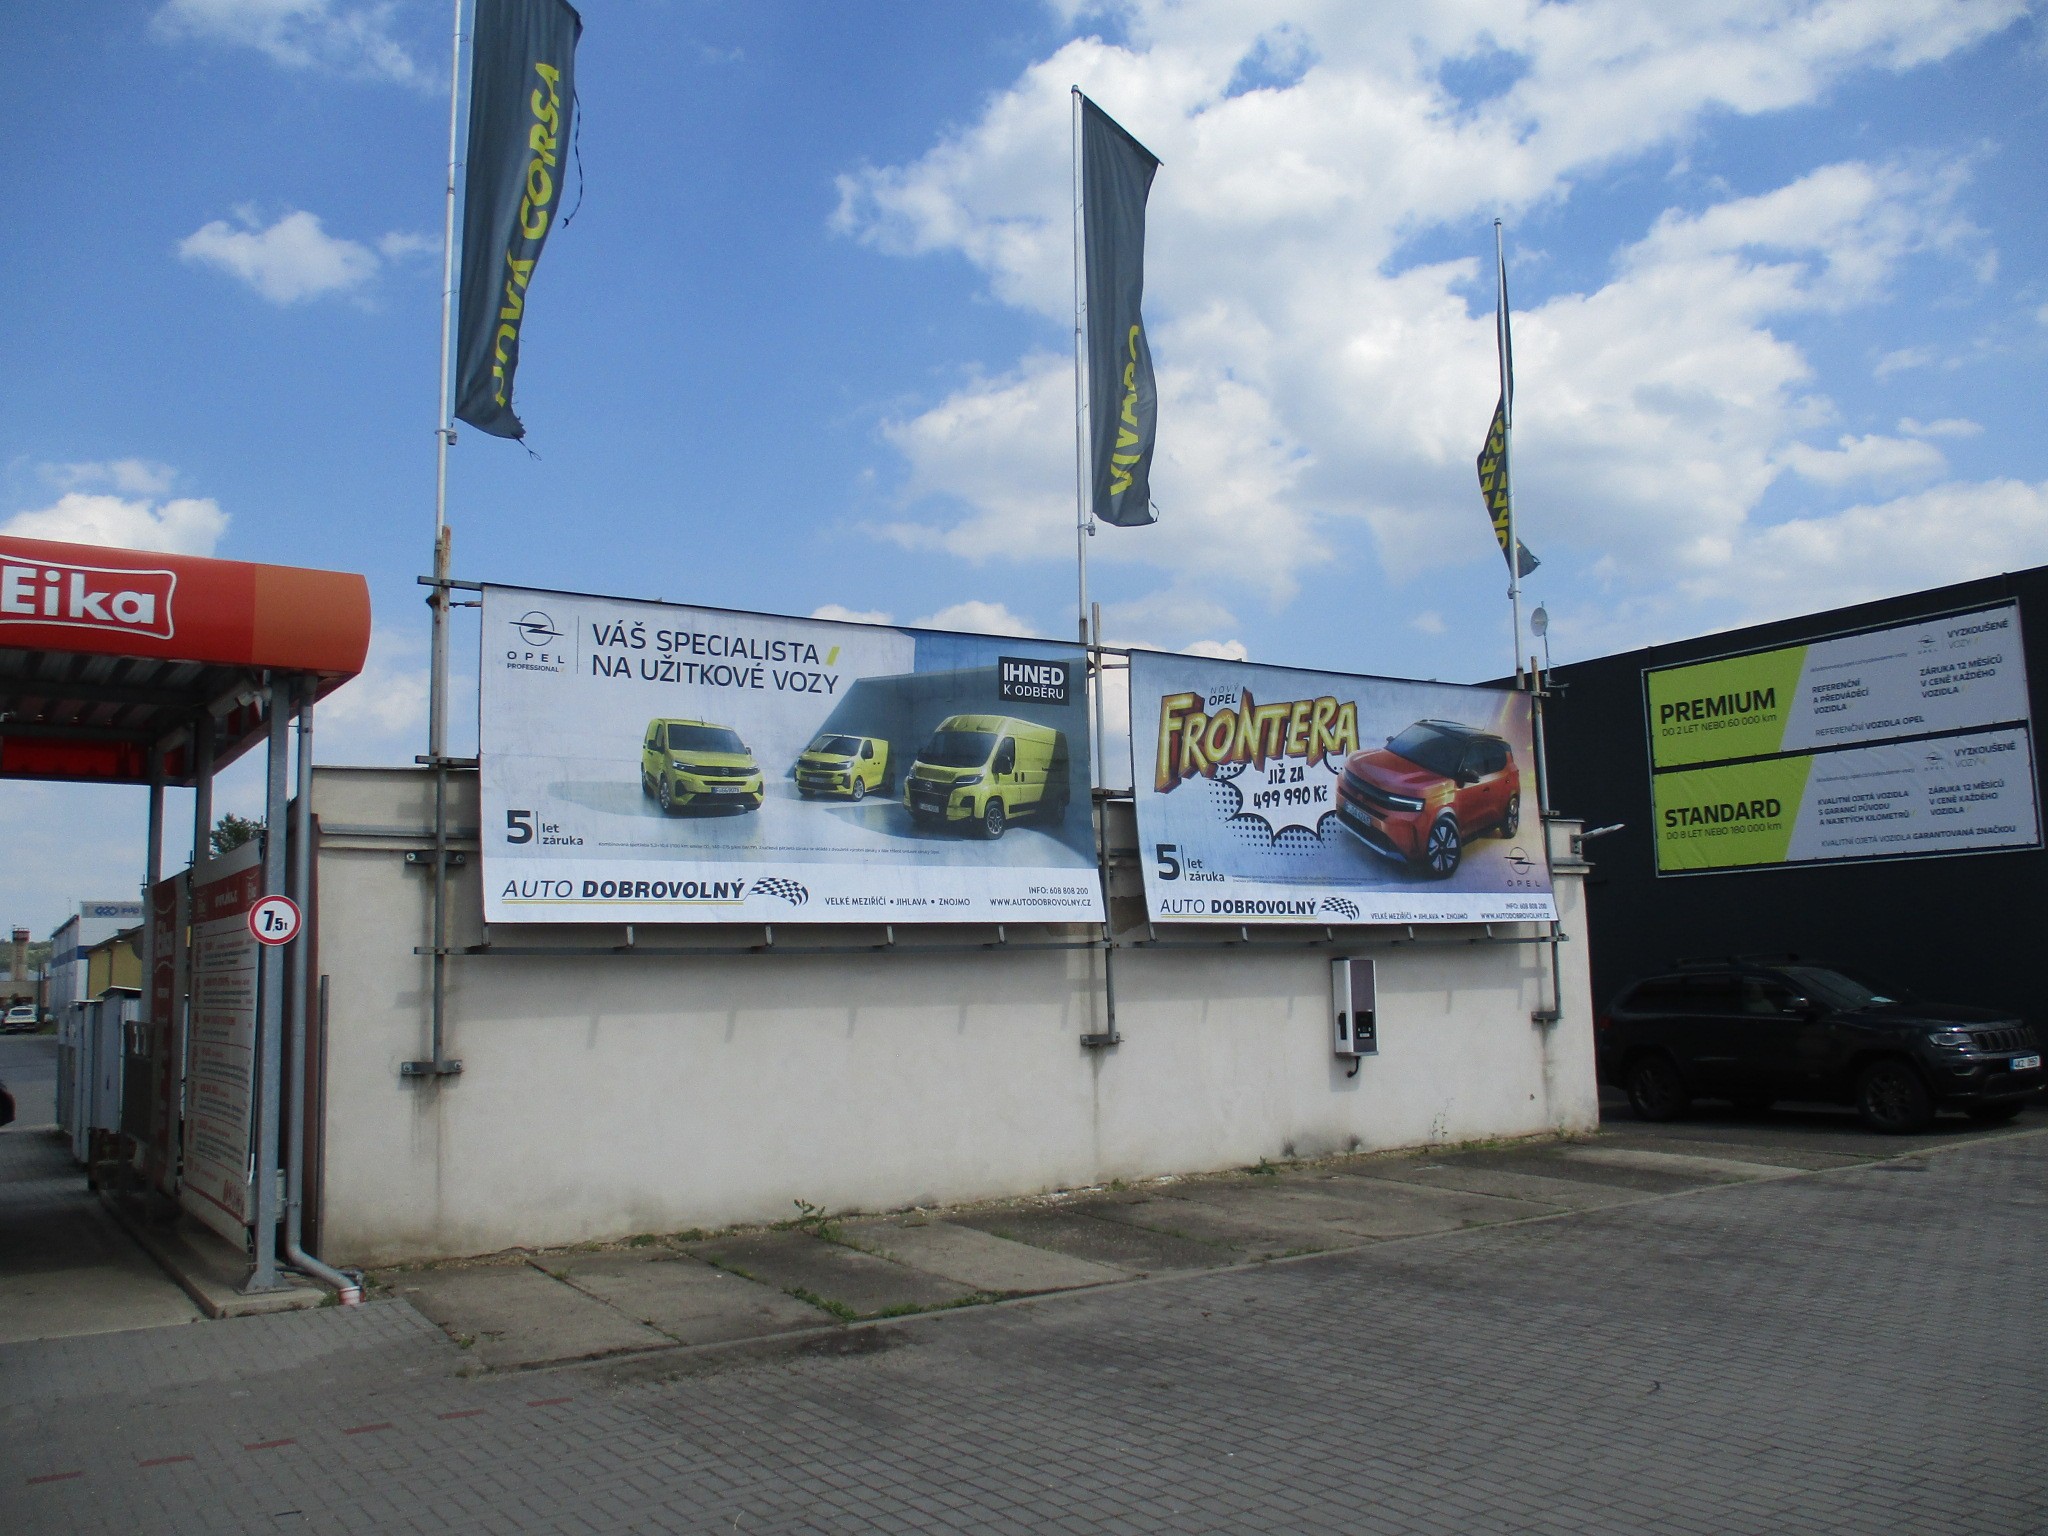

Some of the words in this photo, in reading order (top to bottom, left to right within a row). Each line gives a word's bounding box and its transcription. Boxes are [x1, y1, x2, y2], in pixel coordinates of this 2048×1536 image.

[520, 62, 560, 240] CORSA
[1, 565, 156, 625] Eika
[1947, 618, 2009, 638] VYZKOUŠENÉ
[592, 619, 648, 649] VÁŠ
[656, 630, 820, 665] SPECIALISTA
[507, 651, 565, 664] OPEL
[507, 662, 560, 673] PROFESSIONAL
[592, 656, 632, 679] NA
[640, 653, 765, 690] UŽITKOVÉ
[772, 670, 840, 695] VOZY
[1003, 663, 1065, 685] IHNED
[1920, 664, 1955, 676] ZÁRUKA
[1004, 684, 1012, 695] K
[1015, 684, 1064, 699] ODBĚRU
[1209, 693, 1237, 706] OPEL
[1921, 686, 1959, 698] VOZIDLA
[1660, 687, 1775, 724] PREMIUM
[1814, 703, 1847, 714] VOZIDLA
[1662, 728, 1674, 737] DO
[1676, 726, 1682, 735] 2
[1684, 724, 1699, 734] LET
[1701, 721, 1725, 731] NEBO
[1728, 718, 1740, 728] 60
[1762, 714, 1777, 722] km
[1865, 718, 1900, 730] VOZIDLA
[1902, 715, 1925, 725] OPEL
[1154, 687, 1361, 794] FRONTERA
[1954, 741, 2015, 757] VYZKOUŠENÉ
[1267, 763, 1286, 784] JIŽ
[1290, 766, 1305, 782] ZA
[1253, 790, 1281, 809] 499
[1284, 787, 1311, 806] 990
[1313, 785, 1328, 802] Kč
[1664, 798, 1781, 828] STANDARD
[506, 809, 533, 845] 5
[542, 822, 560, 834] let
[1667, 831, 1679, 840] DO
[1688, 829, 1702, 838] LET
[1704, 827, 1728, 836] NEBO
[542, 835, 584, 846] záruka
[1156, 844, 1181, 880] 5
[1187, 858, 1203, 870] let
[1189, 869, 1225, 883] záruka
[1507, 880, 1540, 888] OPEL
[502, 880, 573, 898] AUTO
[582, 878, 746, 899] DOBROVOLNÝ
[1029, 886, 1049, 895] INFO:
[824, 896, 850, 906] VELKÉ
[851, 895, 887, 906] MEZIŘÍČÍ
[896, 898, 927, 906] JIHLAVA
[939, 898, 971, 906] ZNOJMO
[989, 898, 1092, 907] WWW.AUTODOBROVOLNY.CZ
[1160, 899, 1206, 914] AUTO
[1211, 898, 1317, 915] DOBROVOLNÝ
